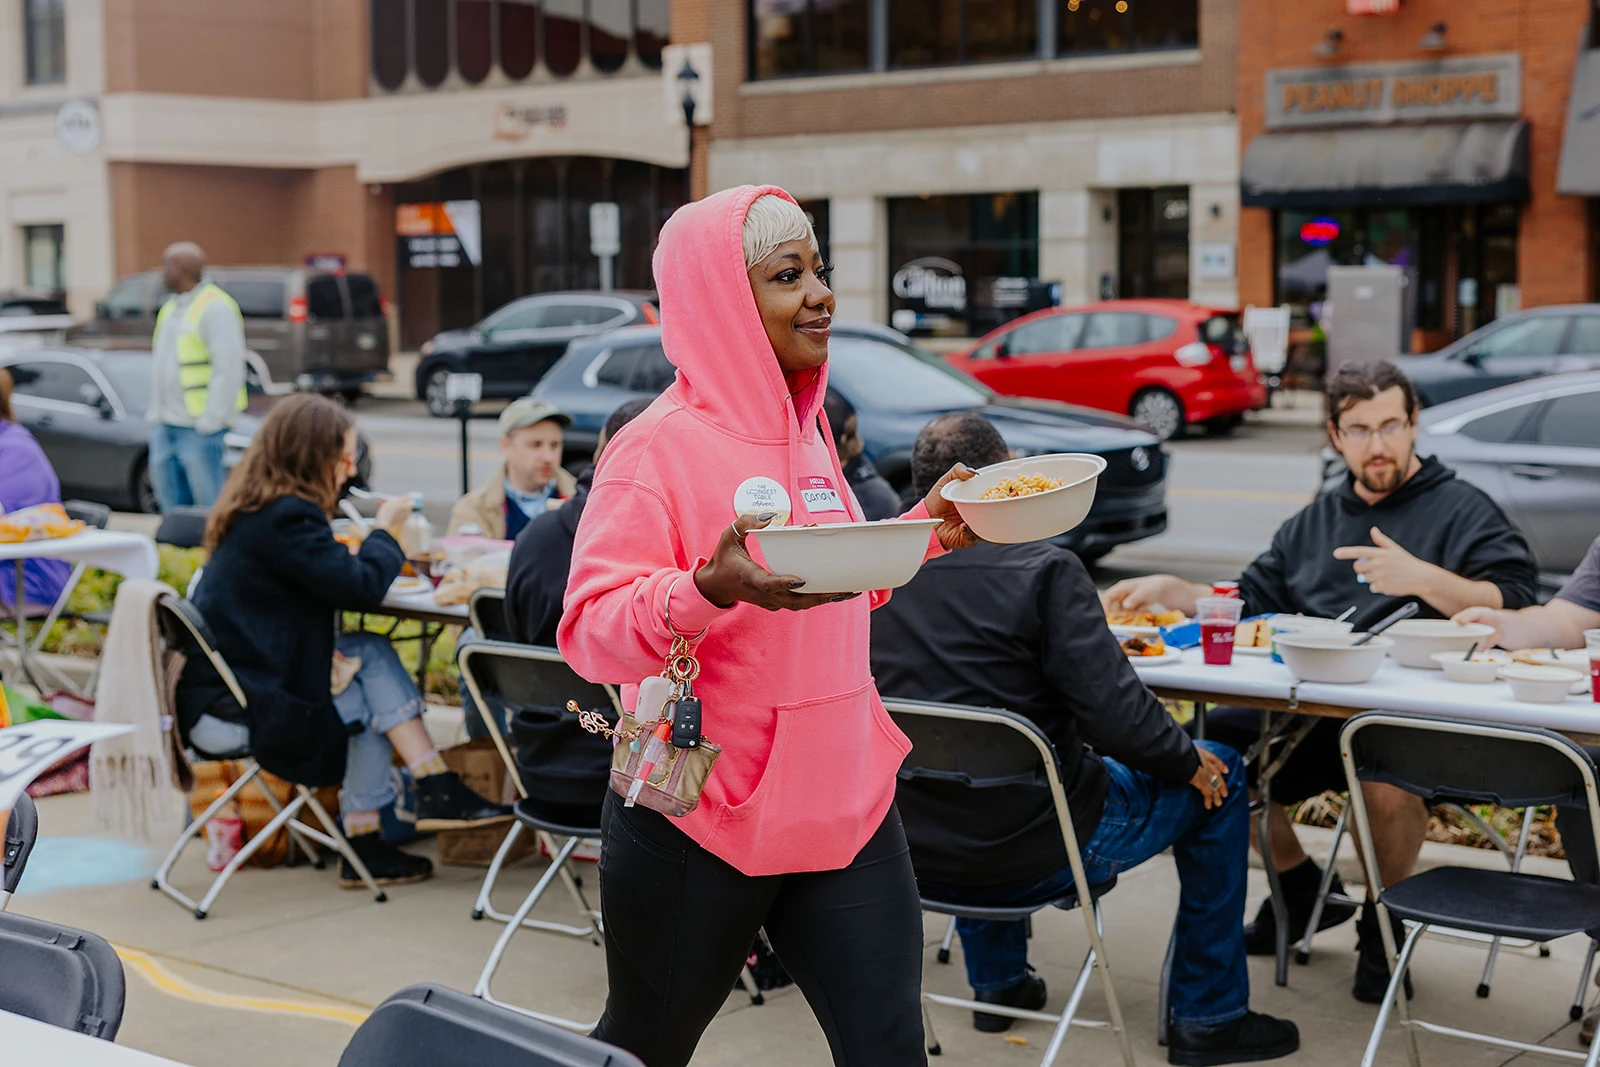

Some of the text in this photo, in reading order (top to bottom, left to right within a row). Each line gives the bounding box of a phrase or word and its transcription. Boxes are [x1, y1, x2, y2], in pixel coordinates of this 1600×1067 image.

[1282, 72, 1497, 113] PEANUT SHOPPE
[804, 491, 833, 503] Candy
